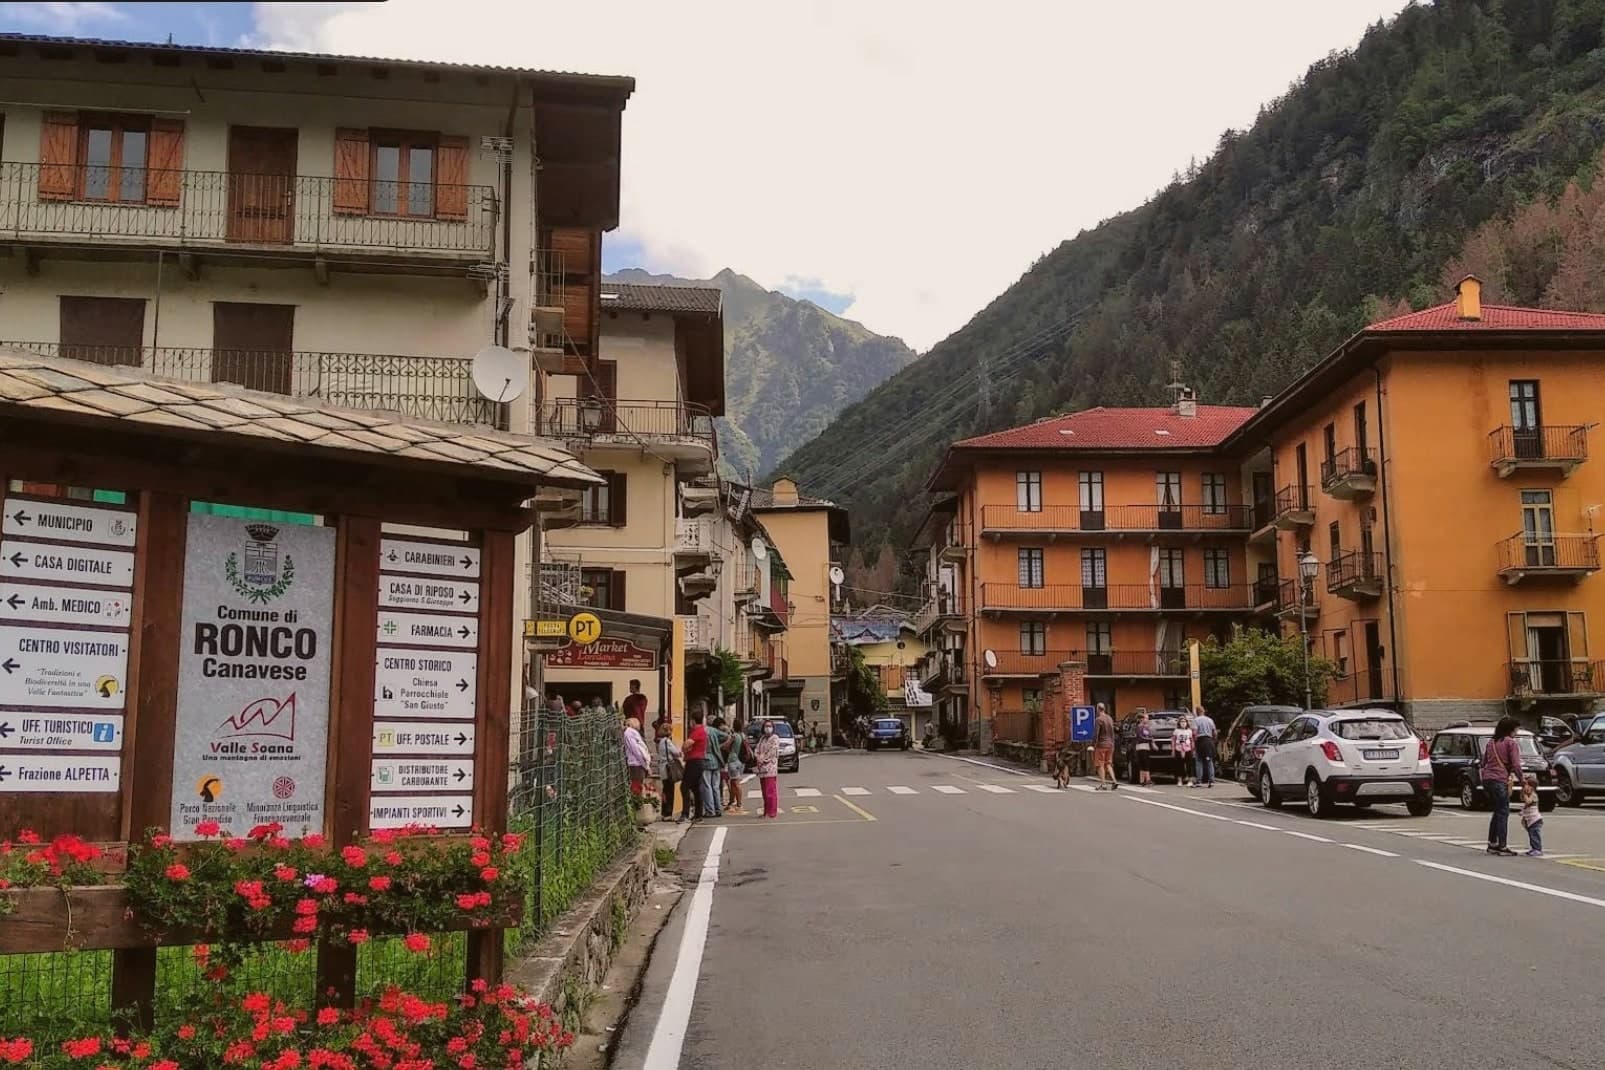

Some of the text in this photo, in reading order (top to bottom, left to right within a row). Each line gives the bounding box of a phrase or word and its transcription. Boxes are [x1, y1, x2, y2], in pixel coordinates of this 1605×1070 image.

[38, 514, 93, 532] MUNICIPIO
[34, 555, 112, 574] CASA DIGITALE
[405, 551, 455, 567] CARABINIERI
[390, 582, 454, 598] CASA DI RIPOSO
[31, 597, 101, 614] Amb. MEDICO
[217, 605, 298, 623] Comune di
[411, 624, 453, 637] FARMACIA
[576, 621, 594, 635] PT
[19, 638, 119, 657] CENTRO VISITATORI
[194, 622, 318, 660] RONCO
[583, 641, 628, 655] Market
[202, 658, 308, 681] Canavese
[384, 657, 452, 672] CENTRO STORICO
[412, 677, 438, 687] Chiesa
[400, 688, 449, 698] Parrocchiale
[1077, 708, 1089, 726] P
[22, 719, 41, 733] UFF.
[44, 720, 93, 734] TURISTICO
[19, 736, 73, 746] Turist Office
[380, 733, 449, 745] PT UFF. POSTALE
[210, 742, 294, 754] Valle Soana
[18, 767, 110, 781] Frazione ALPETTA
[398, 765, 449, 774] DISTRIBUTORE
[401, 776, 449, 786] CARBURANTE
[180, 803, 236, 813] Parco Nazionale
[283, 802, 319, 813] Linguistica
[373, 807, 447, 819] IMPIANTI SPORTIVI
[183, 815, 200, 825] Gran
